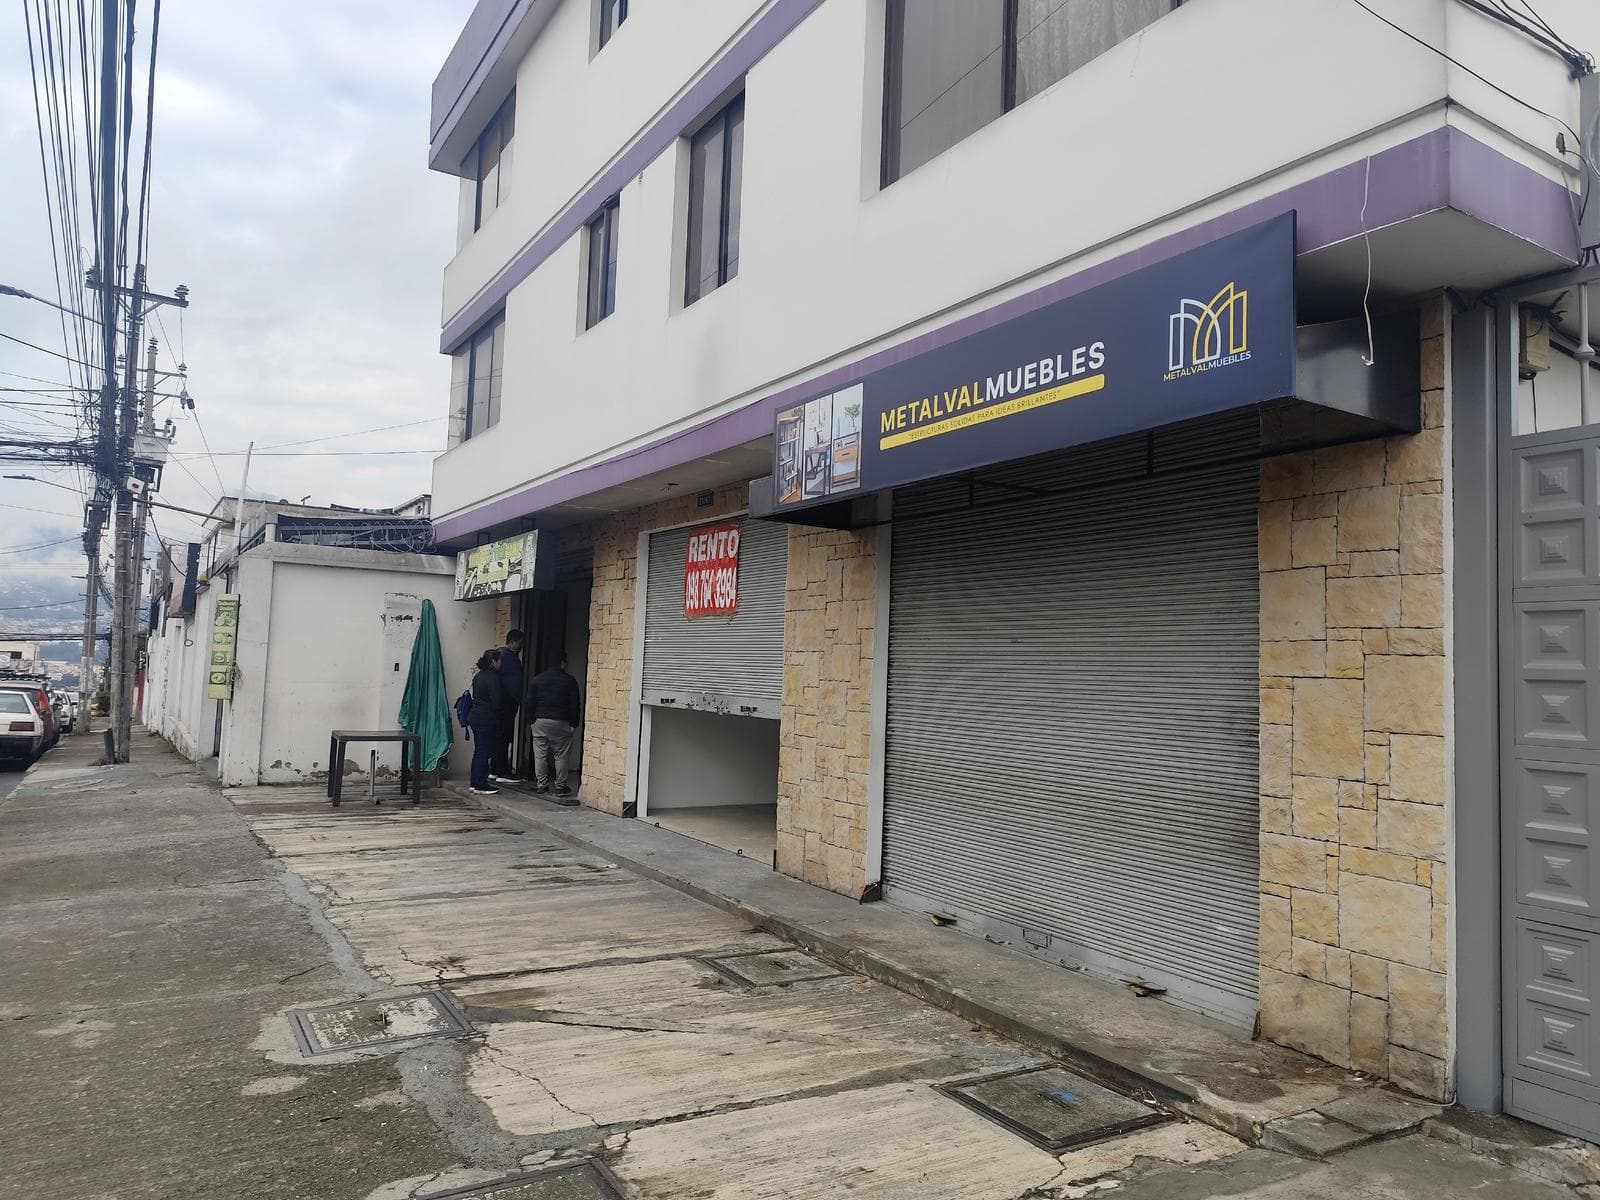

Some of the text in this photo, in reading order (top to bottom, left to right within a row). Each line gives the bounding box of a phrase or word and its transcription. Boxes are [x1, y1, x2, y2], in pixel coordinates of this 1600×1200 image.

[1163, 350, 1252, 382] METALVALMUEBLES
[881, 341, 1105, 433] METALVALMUEBLES
[977, 410, 994, 421] PARA
[995, 402, 1015, 417] IDEAS
[688, 529, 739, 563] RENTO
[714, 566, 737, 608] 3984
